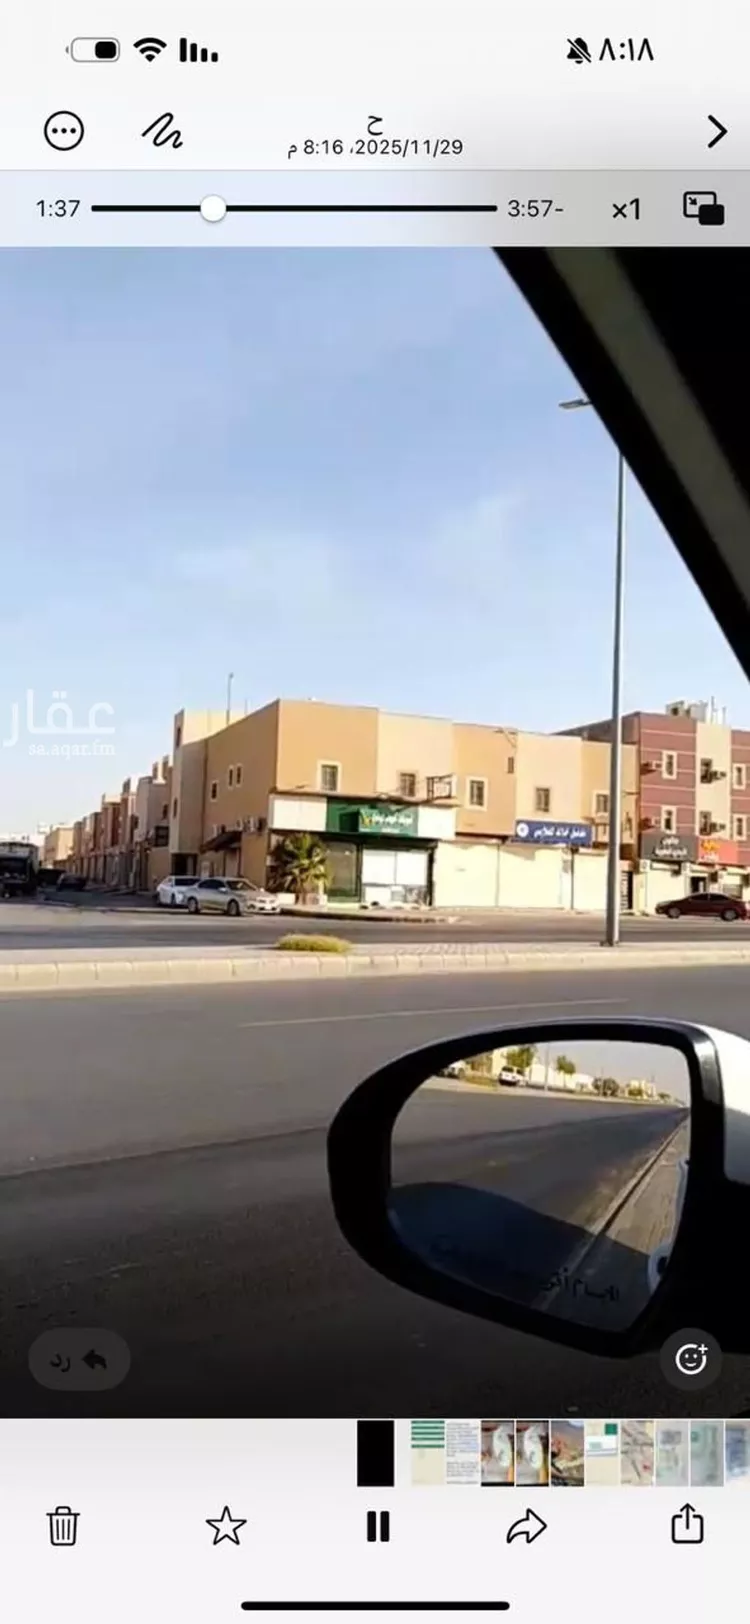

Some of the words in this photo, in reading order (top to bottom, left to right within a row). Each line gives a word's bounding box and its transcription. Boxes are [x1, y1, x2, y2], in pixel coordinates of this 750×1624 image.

[366, 115, 384, 136] ح
[286, 144, 299, 159] م
[303, 139, 345, 155] 8:16
[36, 199, 81, 218] 1:37
[49, 1353, 72, 1373] رد
